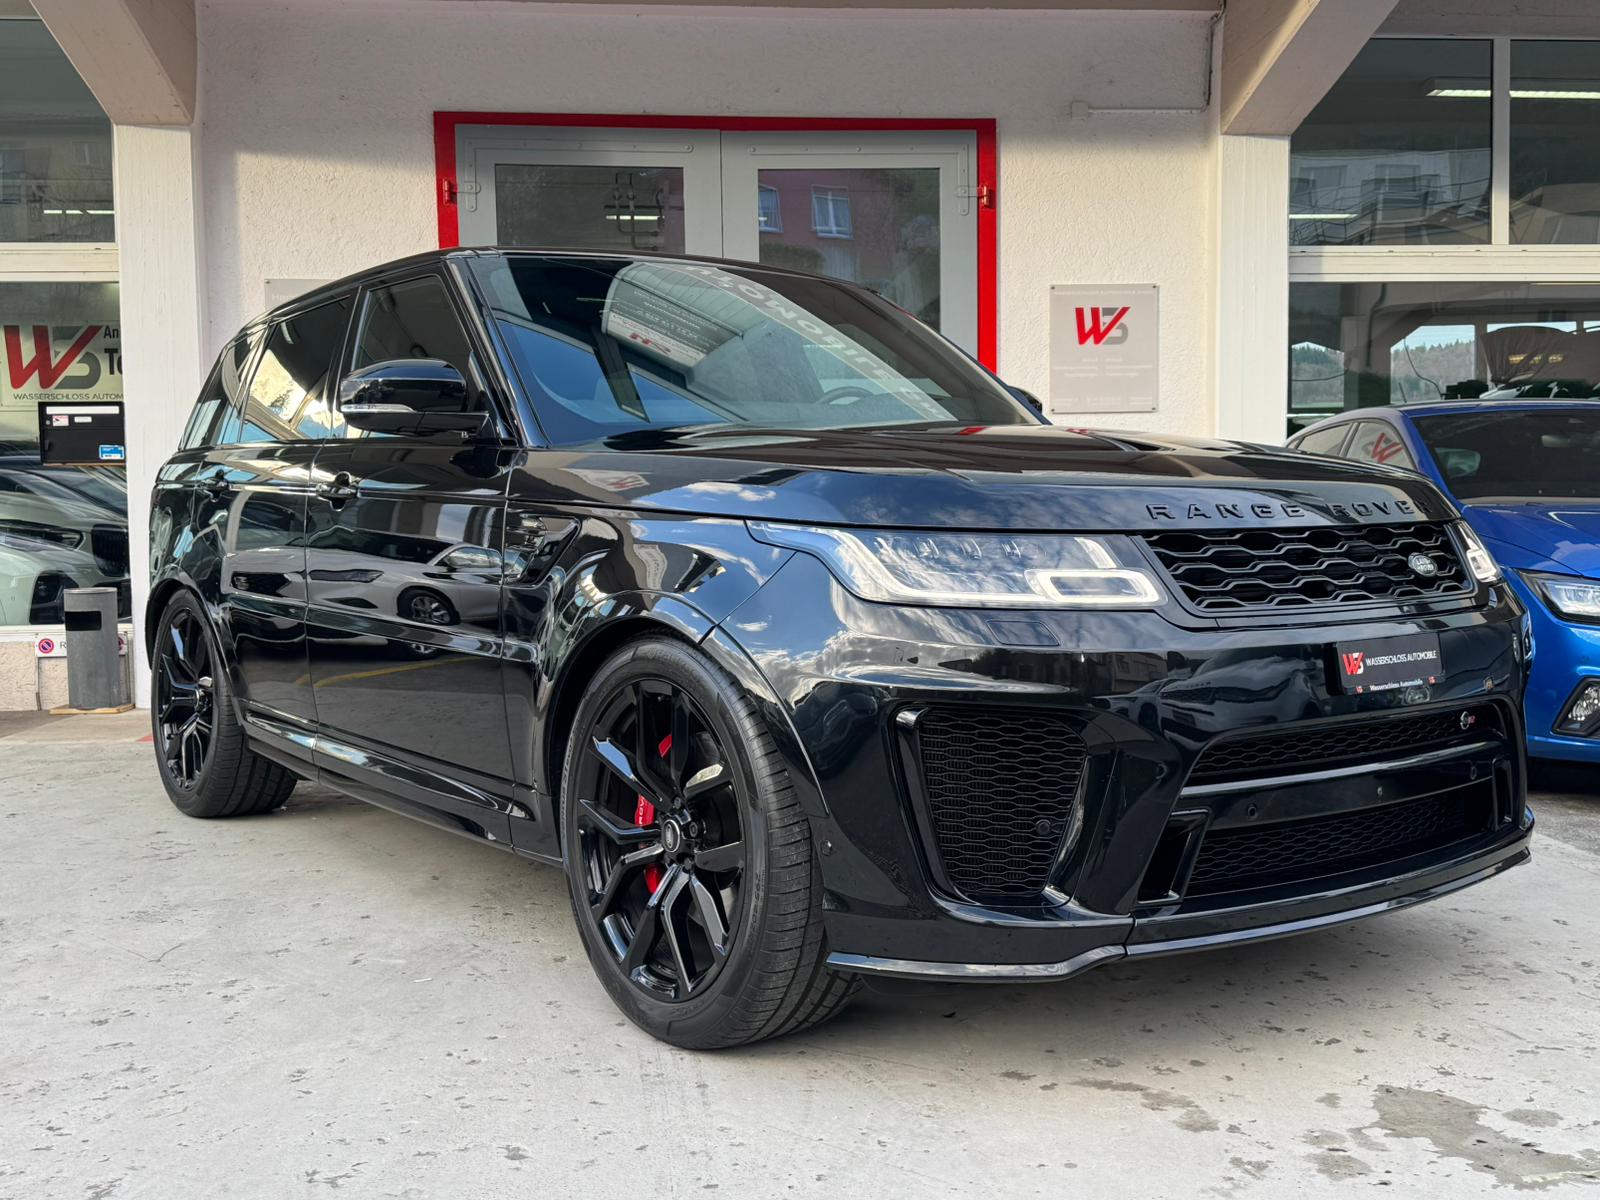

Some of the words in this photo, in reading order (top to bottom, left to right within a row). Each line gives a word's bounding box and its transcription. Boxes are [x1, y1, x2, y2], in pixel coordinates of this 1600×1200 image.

[1145, 502, 1305, 520] RANGE
[1366, 655, 1407, 666] WASSERSCHLOSS
[1407, 650, 1438, 661] AUTOMOBILE
